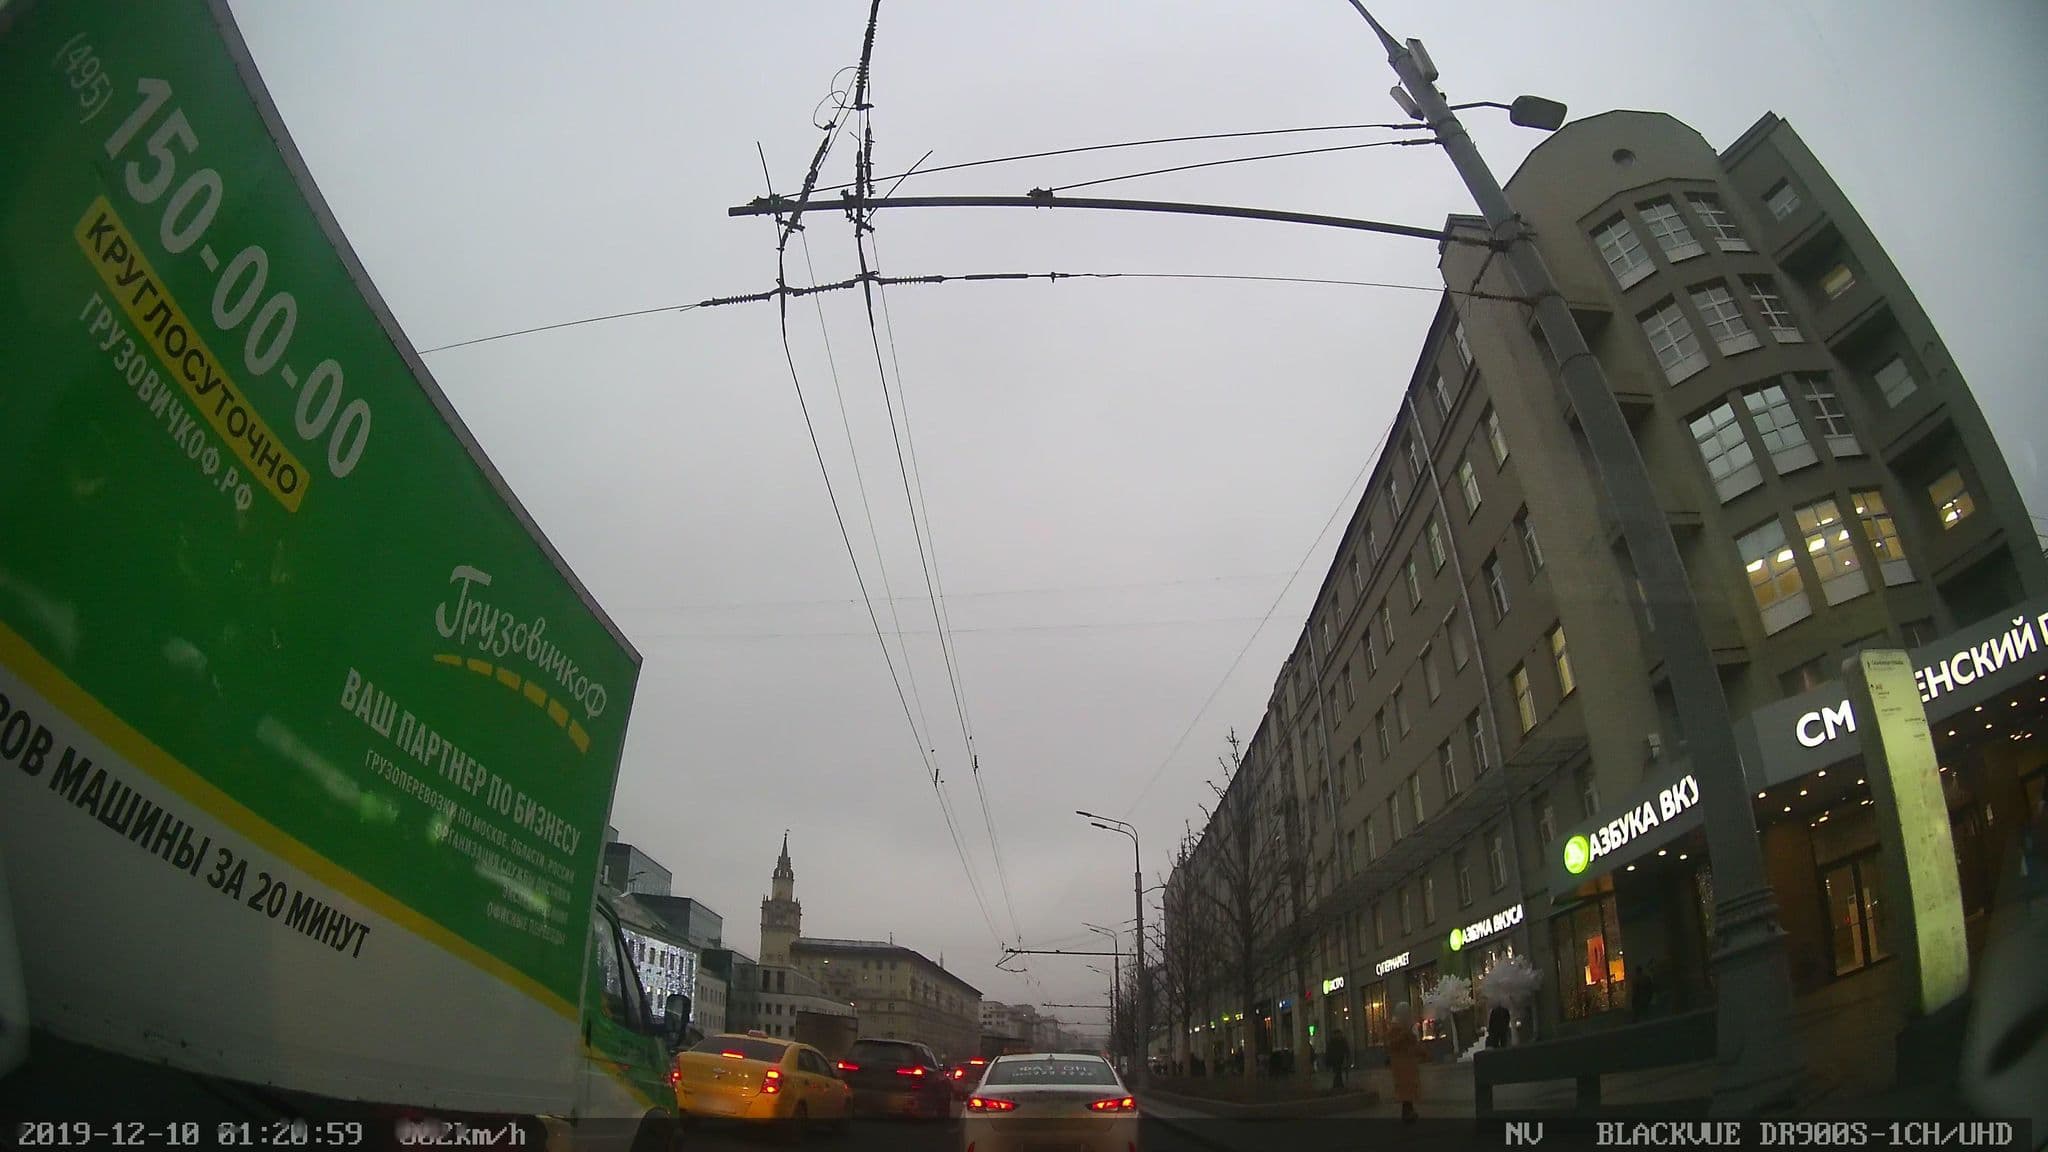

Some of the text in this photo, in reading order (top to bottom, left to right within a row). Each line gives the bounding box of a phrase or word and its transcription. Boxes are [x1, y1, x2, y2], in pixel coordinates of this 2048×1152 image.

[51, 31, 113, 124] (495)
[86, 213, 300, 496] КРУГЛОСУТОЧНО
[104, 77, 371, 478] 150-00-00
[79, 292, 253, 512] ГРУЗОВИЧКОФ.РФ
[49, 746, 211, 877] МАШИНЫ
[206, 847, 249, 900] ЗА
[247, 872, 287, 919] 20
[285, 890, 371, 958] МИНУТ
[340, 667, 581, 856] ВАШ ПАРТНЕР ПО БИЗНЕСУ
[365, 750, 458, 819] ГРУЗОПЕРЕВОЗКИ
[458, 808, 472, 828] ПО
[1589, 801, 1660, 862] АЗБУКА
[1493, 904, 1523, 932] ВКУСА
